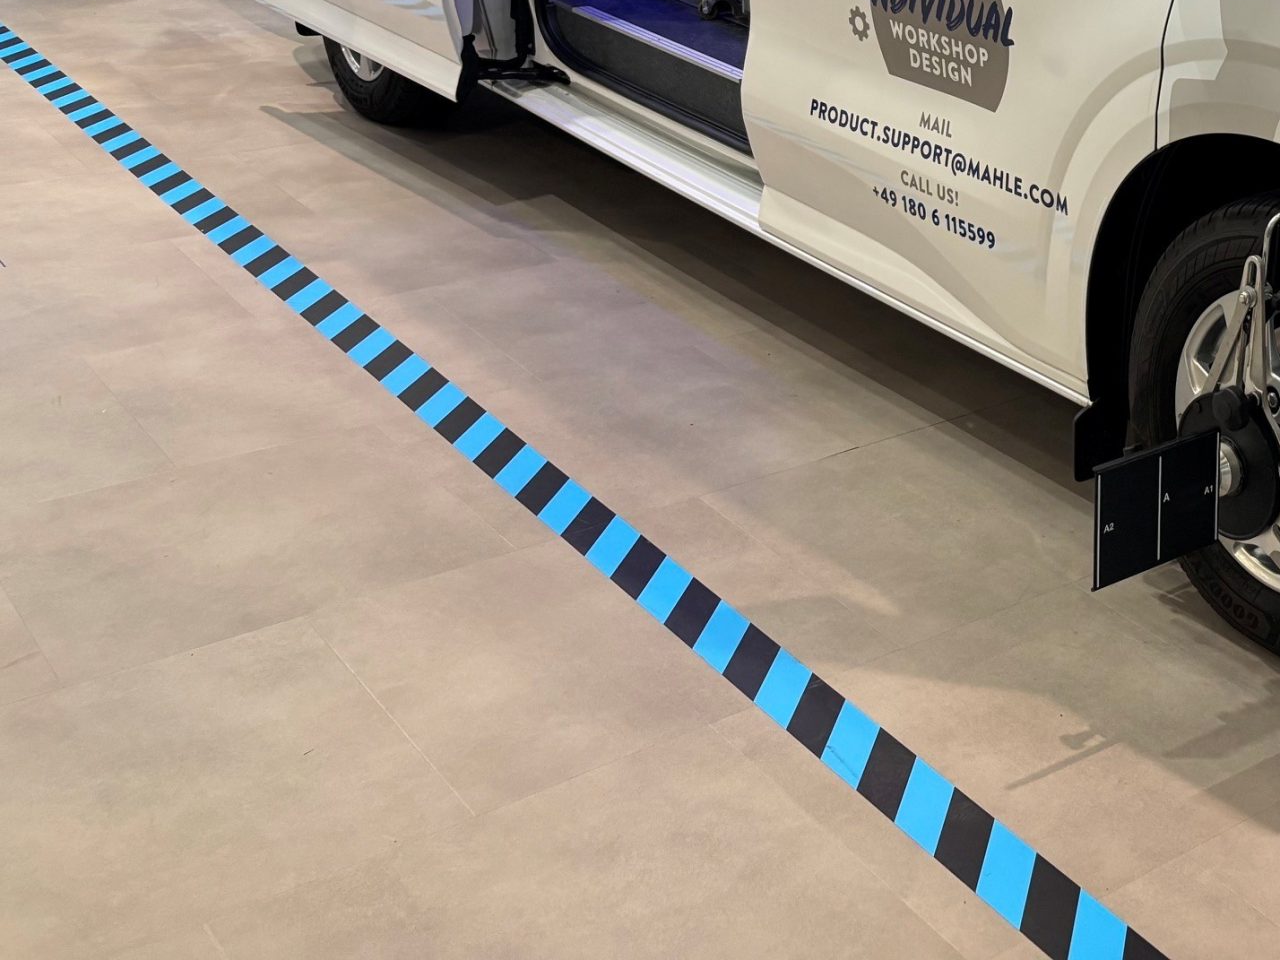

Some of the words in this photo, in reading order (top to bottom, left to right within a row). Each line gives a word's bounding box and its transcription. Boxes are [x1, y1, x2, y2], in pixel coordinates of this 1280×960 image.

[889, 19, 989, 67] WORKSHOP
[909, 48, 972, 87] DESIGN
[919, 111, 952, 138] MAIL
[809, 98, 1068, 216] PRODUCT.SUPPORT@MAHLE.COM
[900, 169, 933, 196] CALL
[936, 183, 959, 207] US!
[872, 186, 898, 208] +49
[901, 195, 926, 221] 180
[931, 208, 940, 226] 6
[944, 213, 996, 249] 115599
[1162, 492, 1171, 503] A
[1203, 484, 1214, 496] A1
[1103, 522, 1115, 534] A2
